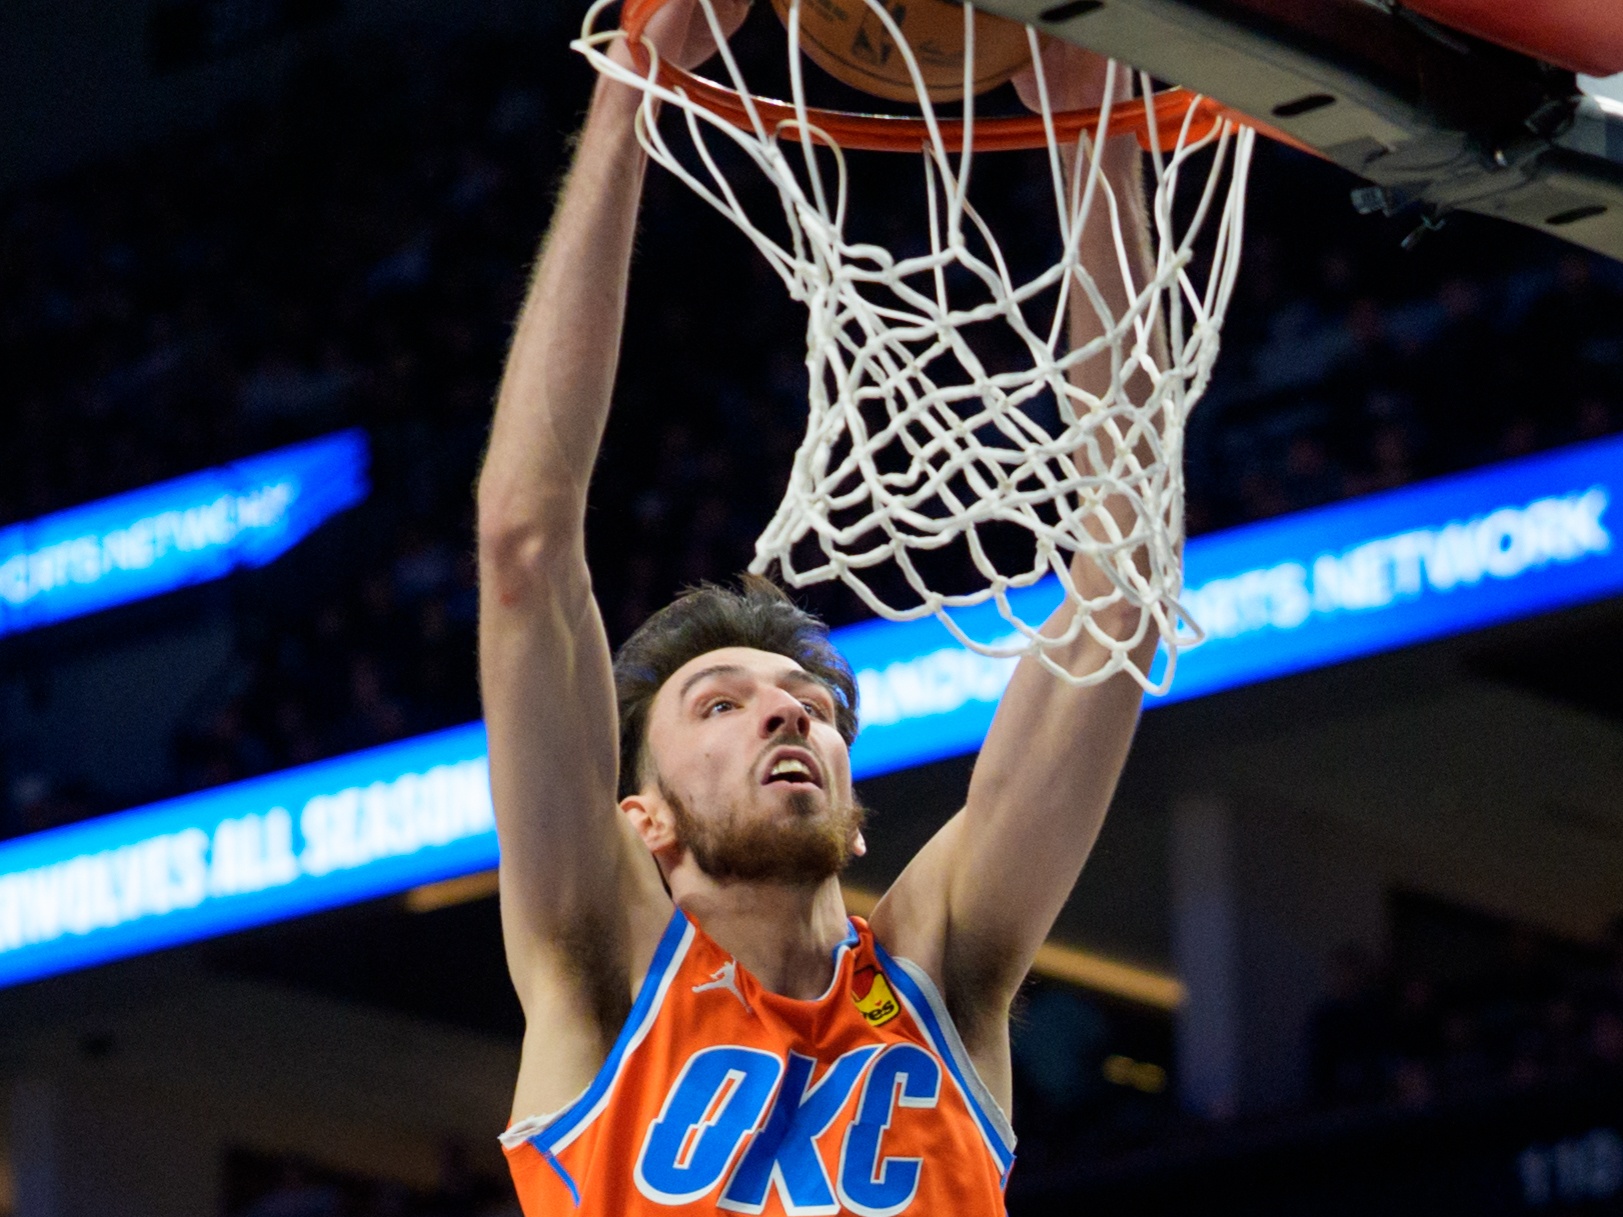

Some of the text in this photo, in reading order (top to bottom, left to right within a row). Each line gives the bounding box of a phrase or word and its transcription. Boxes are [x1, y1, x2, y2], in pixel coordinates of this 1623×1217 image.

[1313, 490, 1609, 613] NETWORK
[208, 808, 299, 898] ALL
[300, 757, 493, 876] SEASON
